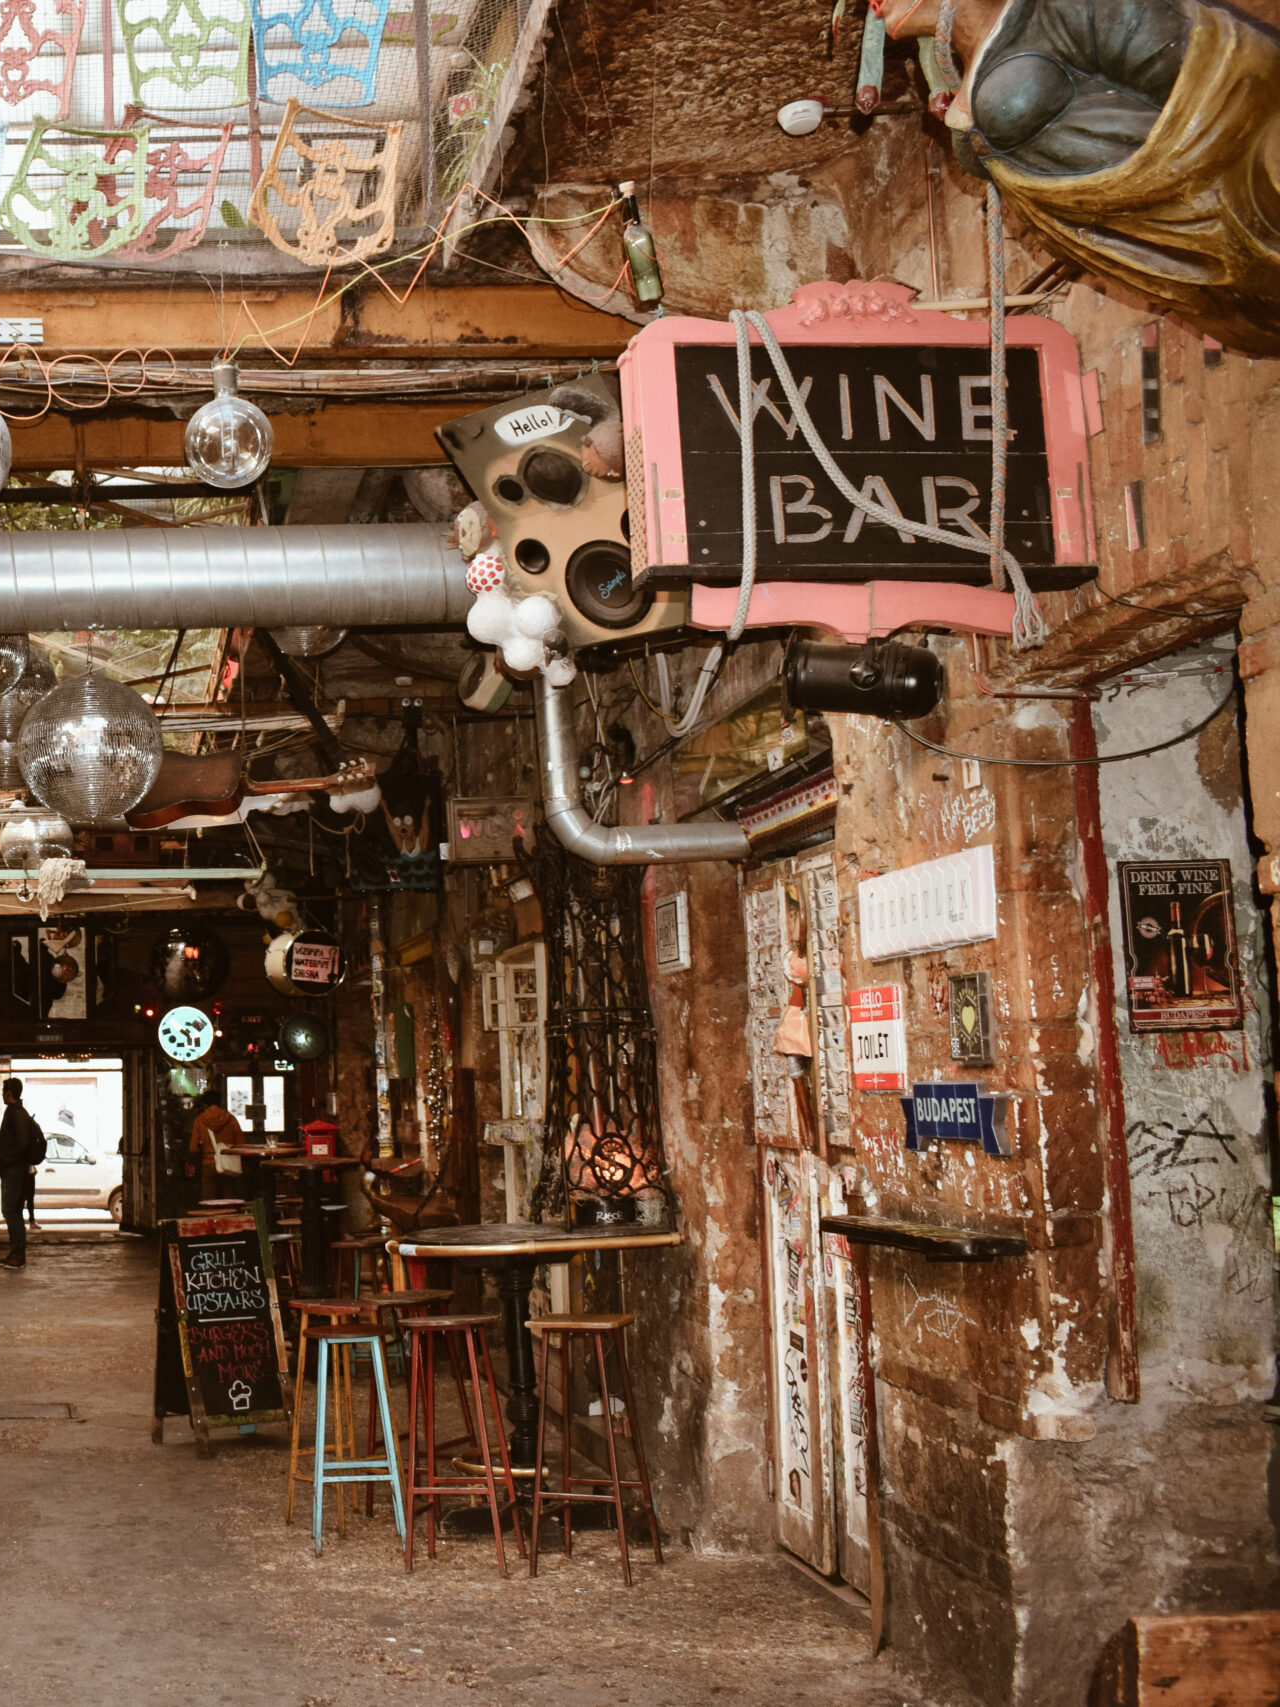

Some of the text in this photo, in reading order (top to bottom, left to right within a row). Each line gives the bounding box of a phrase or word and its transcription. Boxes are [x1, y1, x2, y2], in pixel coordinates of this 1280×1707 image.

[706, 373, 1018, 441] WINE
[509, 410, 553, 438] Hello!
[769, 474, 993, 544] BAR
[1130, 869, 1219, 883] DRINK WINE
[1138, 882, 1213, 895] FEEL FINE
[293, 969, 319, 980] SHISHA
[860, 991, 882, 1008] HELLO
[1160, 1011, 1210, 1019] BUDAPEST
[858, 1033, 889, 1060] TOILET
[916, 1097, 976, 1124] BUDAPEST
[190, 1248, 245, 1270] GRILL
[185, 1266, 261, 1292] KITCHEN
[185, 1289, 266, 1315] UPSTAIRS
[186, 1322, 269, 1345] BURGERS
[196, 1340, 272, 1363] AND MUCH
[217, 1360, 265, 1384] MORE
